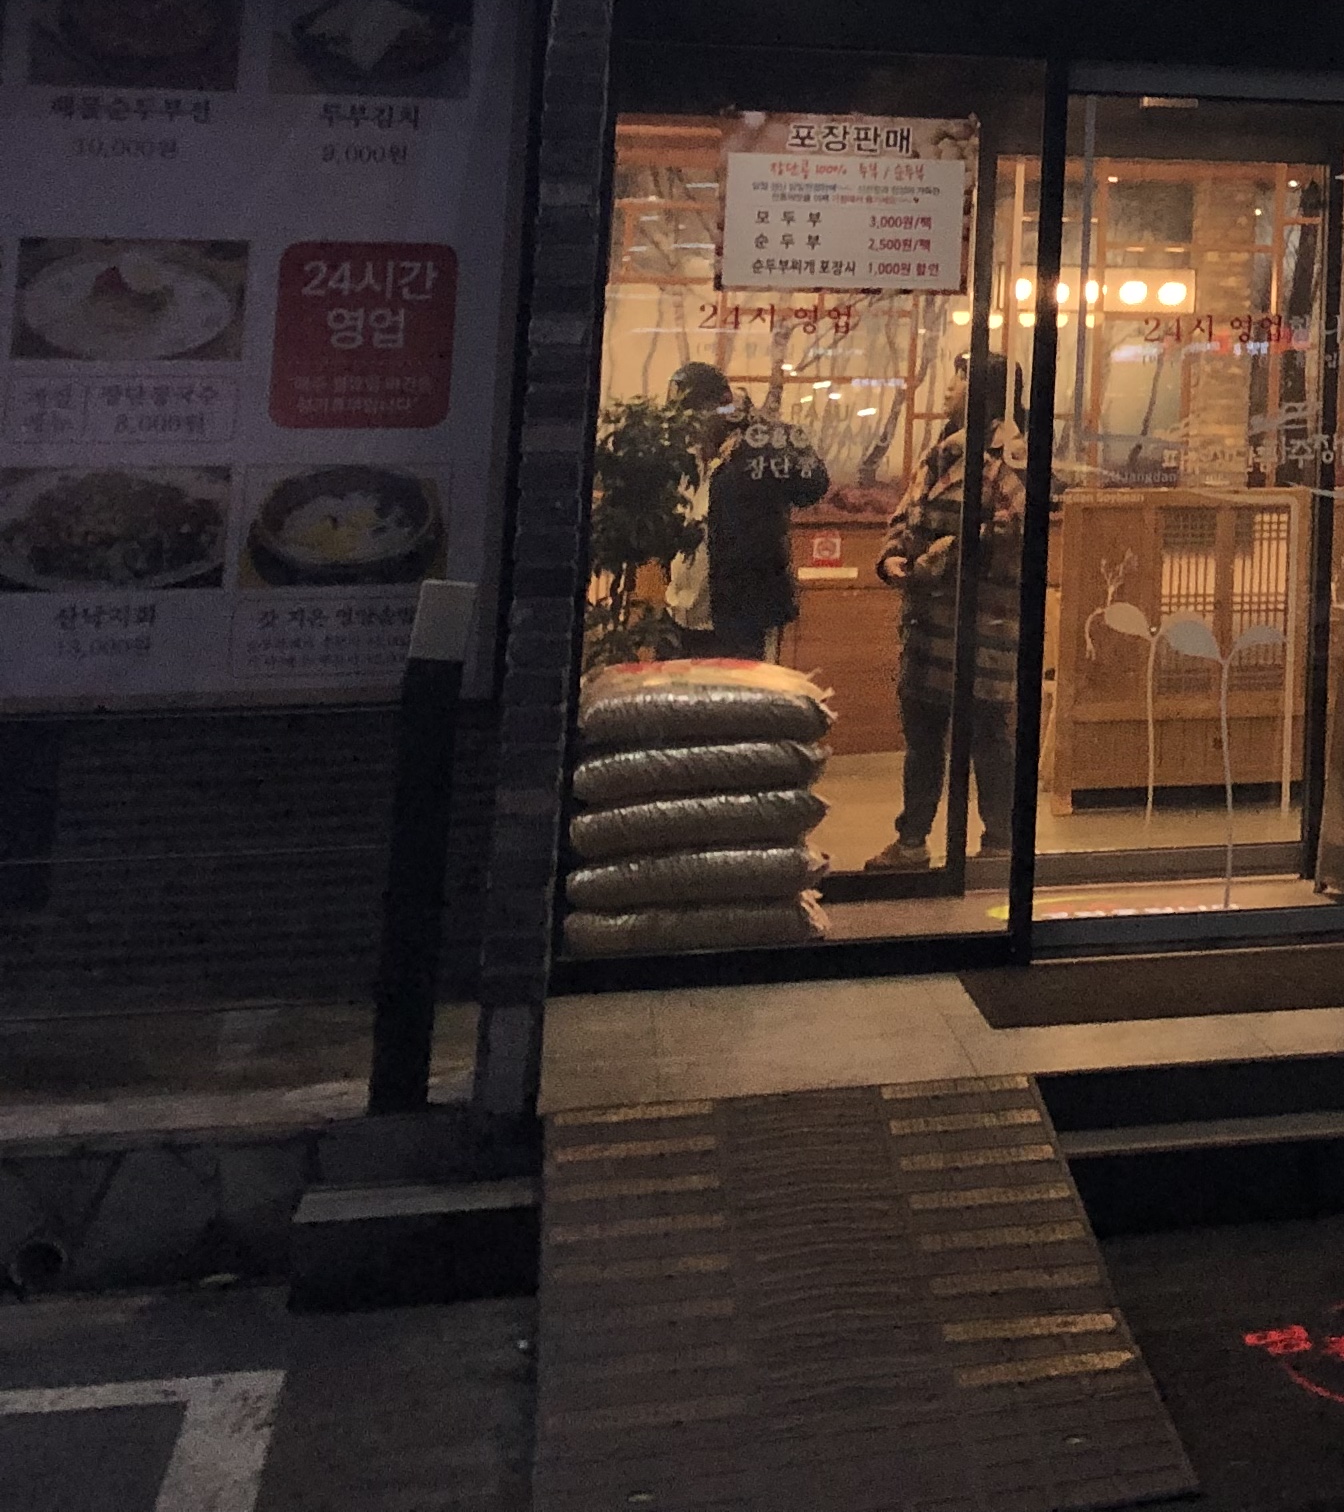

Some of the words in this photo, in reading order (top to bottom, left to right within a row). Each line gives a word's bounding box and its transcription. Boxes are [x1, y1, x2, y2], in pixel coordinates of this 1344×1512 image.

[788, 124, 913, 155] 포장판매
[300, 260, 442, 301] 24시간
[324, 306, 407, 351] 영업
[794, 304, 851, 335] 영업
[1229, 314, 1284, 344] 영업
